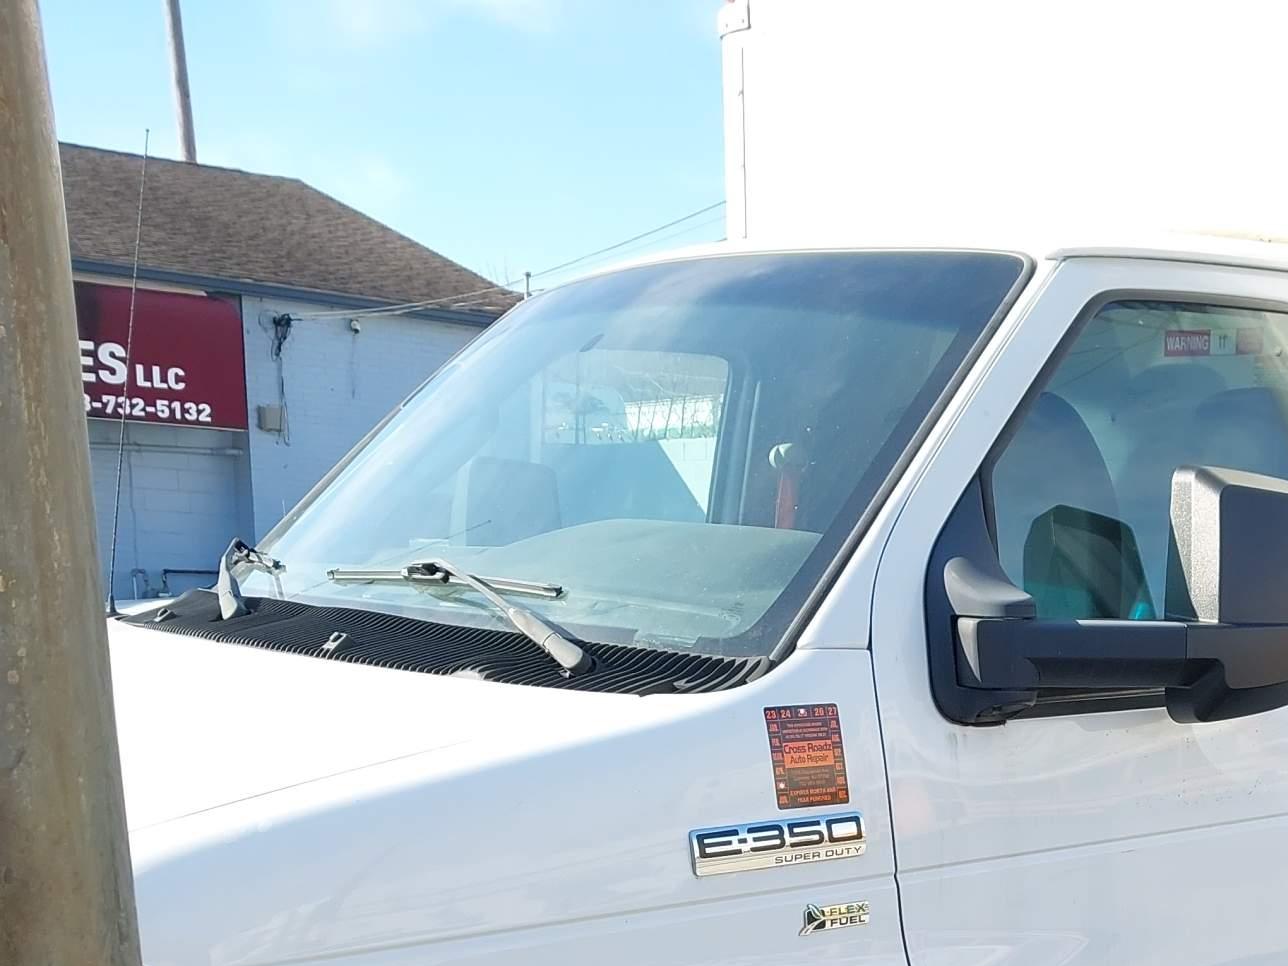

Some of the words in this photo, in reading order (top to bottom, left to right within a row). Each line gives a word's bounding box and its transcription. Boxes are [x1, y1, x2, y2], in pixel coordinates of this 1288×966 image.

[1167, 335, 1209, 352] WARNING
[78, 340, 128, 384] ES
[135, 364, 186, 390] LLC
[783, 745, 807, 754] Cross
[790, 755, 806, 764] Auto
[807, 754, 829, 764] Repair
[774, 852, 821, 864] SUPER
[825, 846, 863, 858] DUTY
[829, 903, 866, 916] FLEX
[830, 916, 866, 927] FUEL
